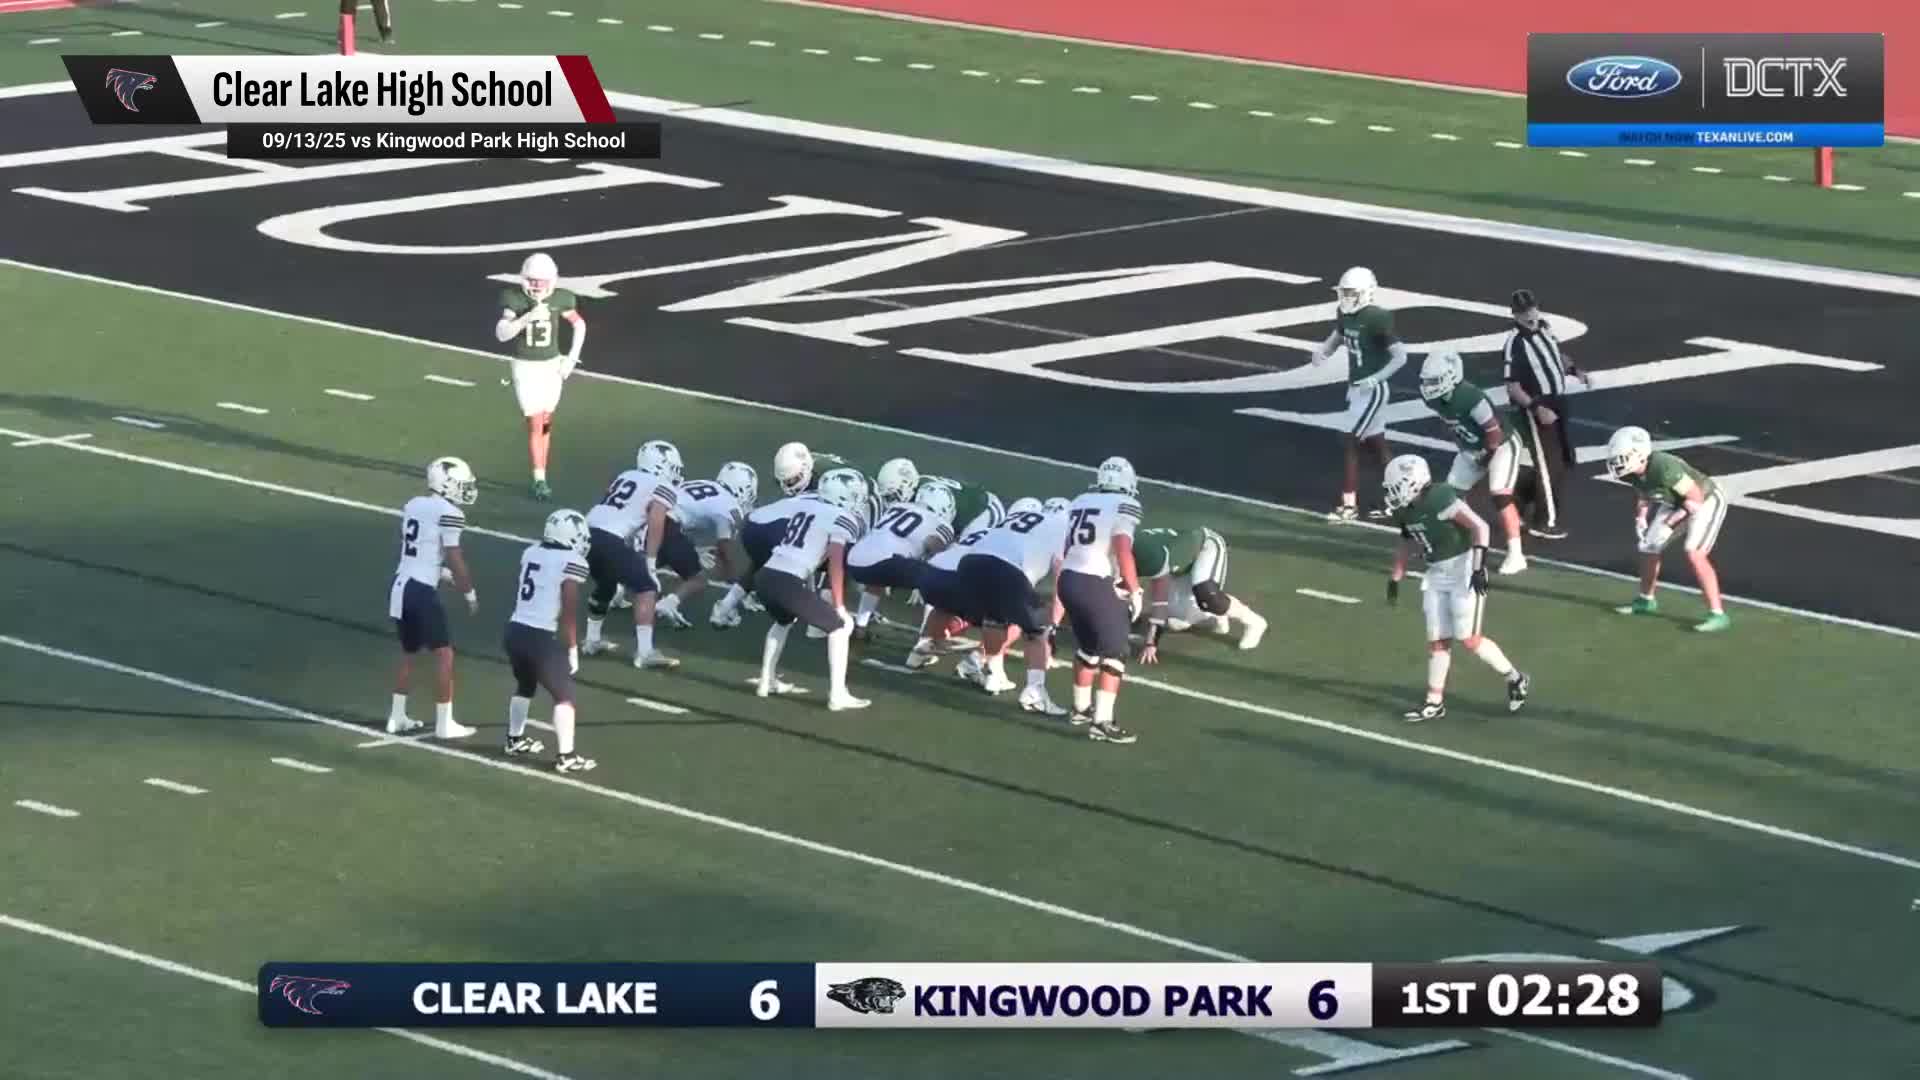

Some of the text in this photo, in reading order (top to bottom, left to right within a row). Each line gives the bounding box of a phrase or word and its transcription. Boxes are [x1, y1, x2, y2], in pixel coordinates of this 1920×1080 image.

[525, 319, 553, 348] 13
[404, 518, 420, 558] 2
[781, 511, 817, 549] 81
[875, 507, 923, 538] 70
[1069, 508, 1102, 546] 75
[520, 562, 541, 602] 5
